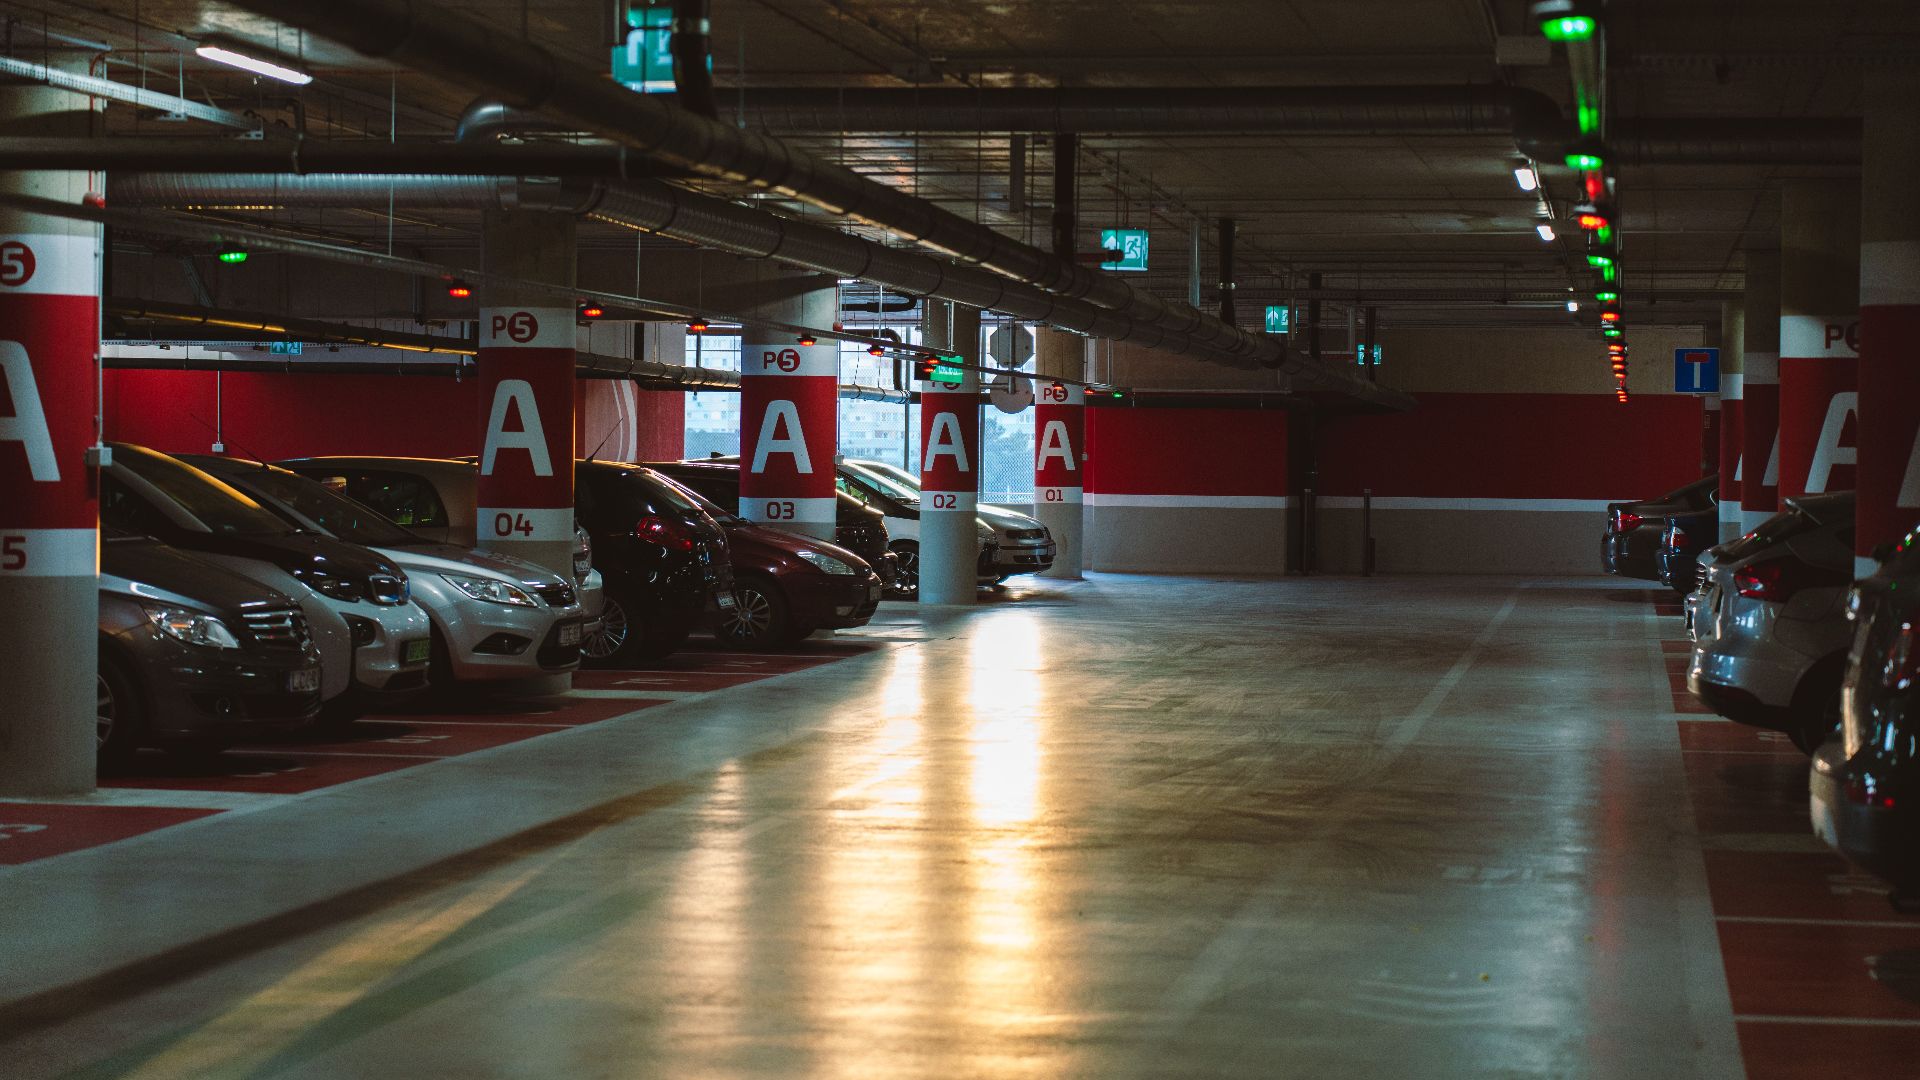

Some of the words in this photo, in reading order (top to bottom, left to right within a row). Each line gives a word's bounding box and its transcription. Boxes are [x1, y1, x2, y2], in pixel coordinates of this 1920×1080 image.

[492, 313, 536, 342] P5
[763, 350, 799, 371] P5
[480, 379, 554, 477] A
[751, 399, 814, 474] A
[923, 411, 970, 472] A
[1036, 420, 1076, 471] A
[933, 494, 957, 509] 02
[1045, 489, 1064, 502] 01
[766, 501, 795, 520] 03
[494, 512, 534, 537] 04
